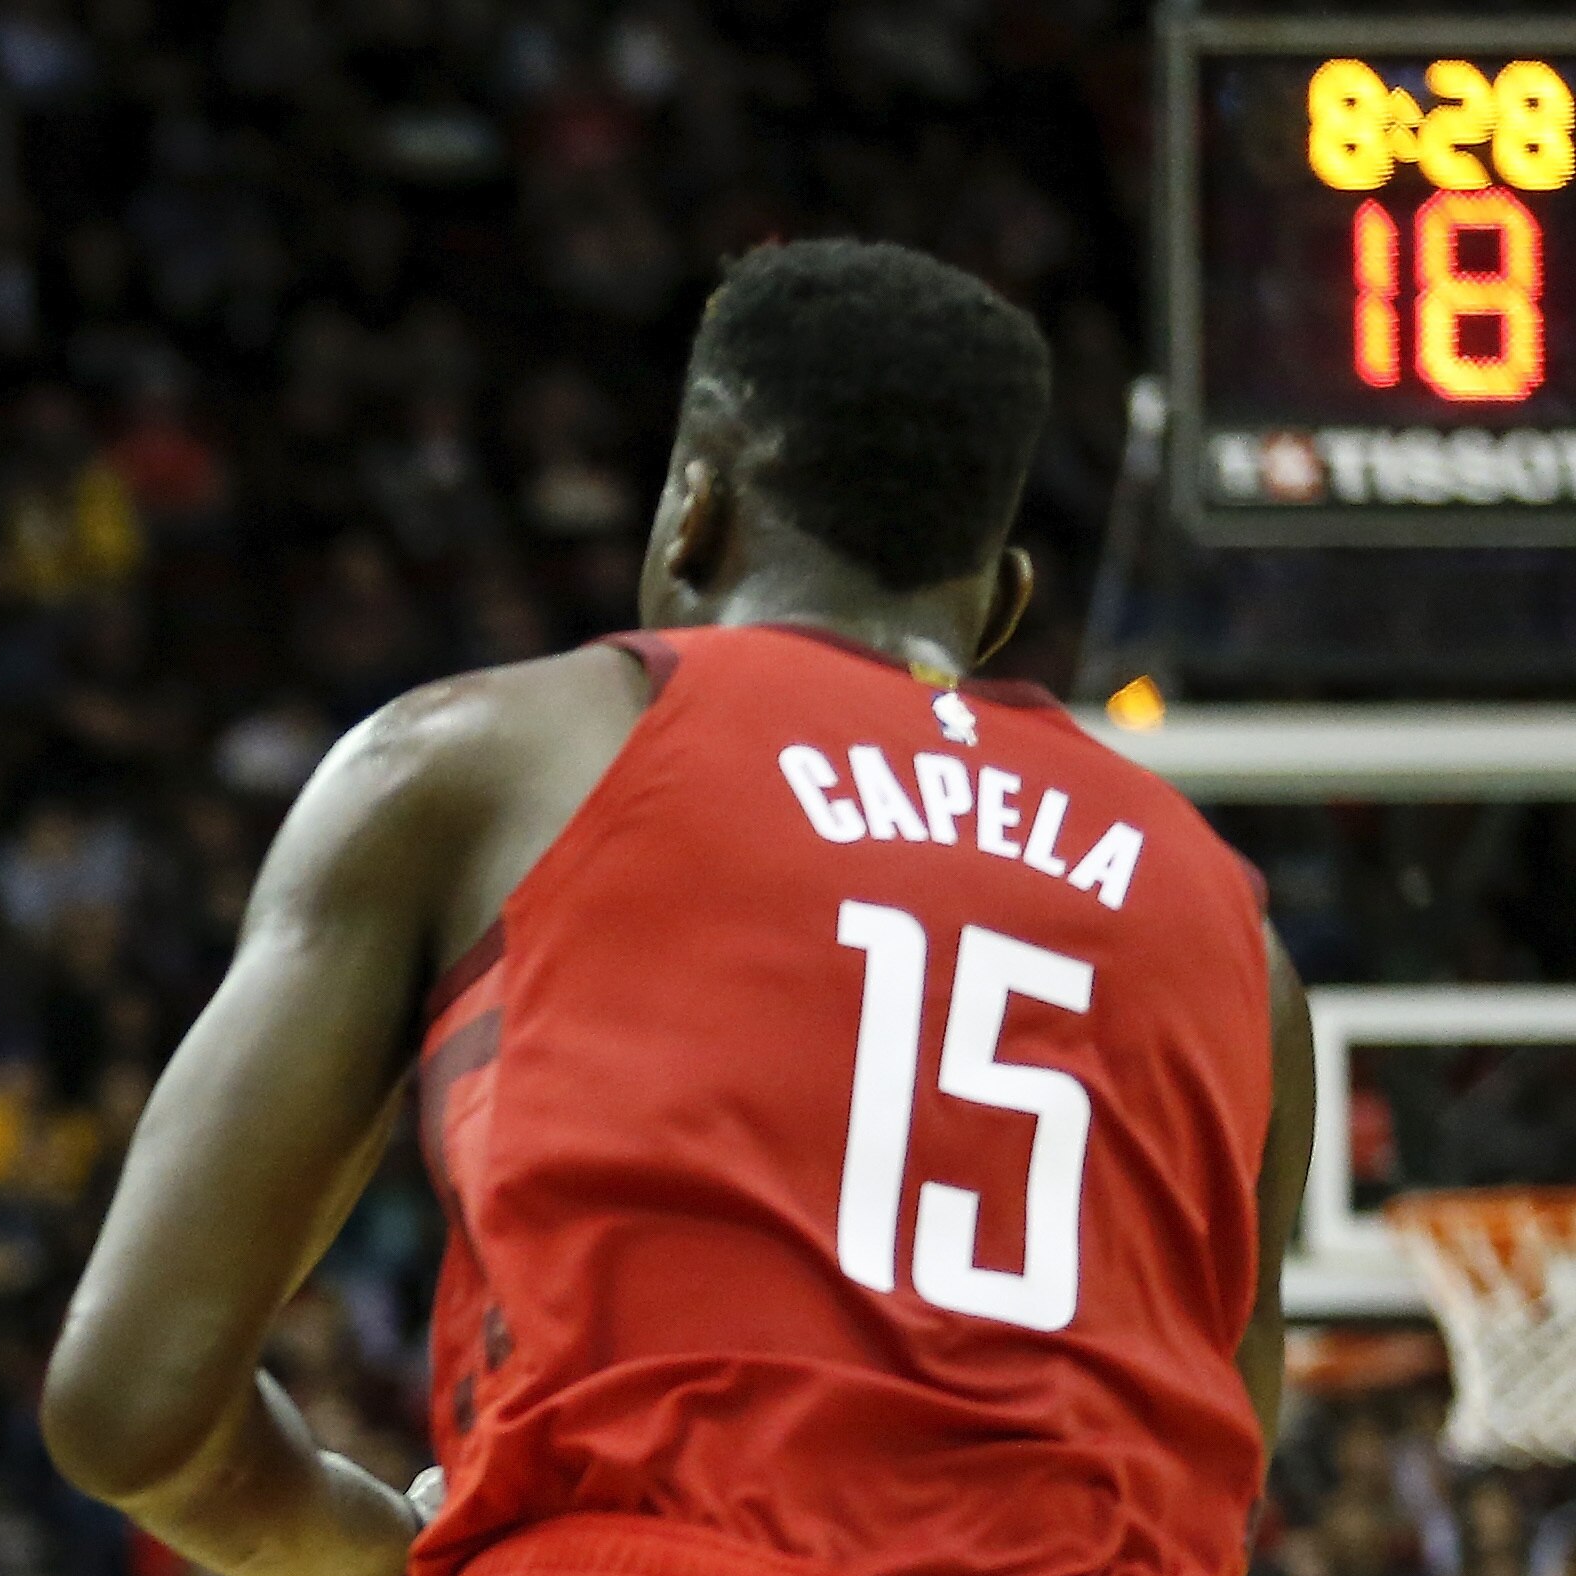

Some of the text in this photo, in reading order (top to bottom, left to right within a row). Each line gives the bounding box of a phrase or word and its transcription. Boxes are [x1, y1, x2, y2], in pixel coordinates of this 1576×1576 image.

[1308, 58, 1575, 190] 8:28
[1352, 186, 1544, 402] 18
[778, 744, 1144, 912] CAPELA
[836, 899, 1096, 1332] 15
